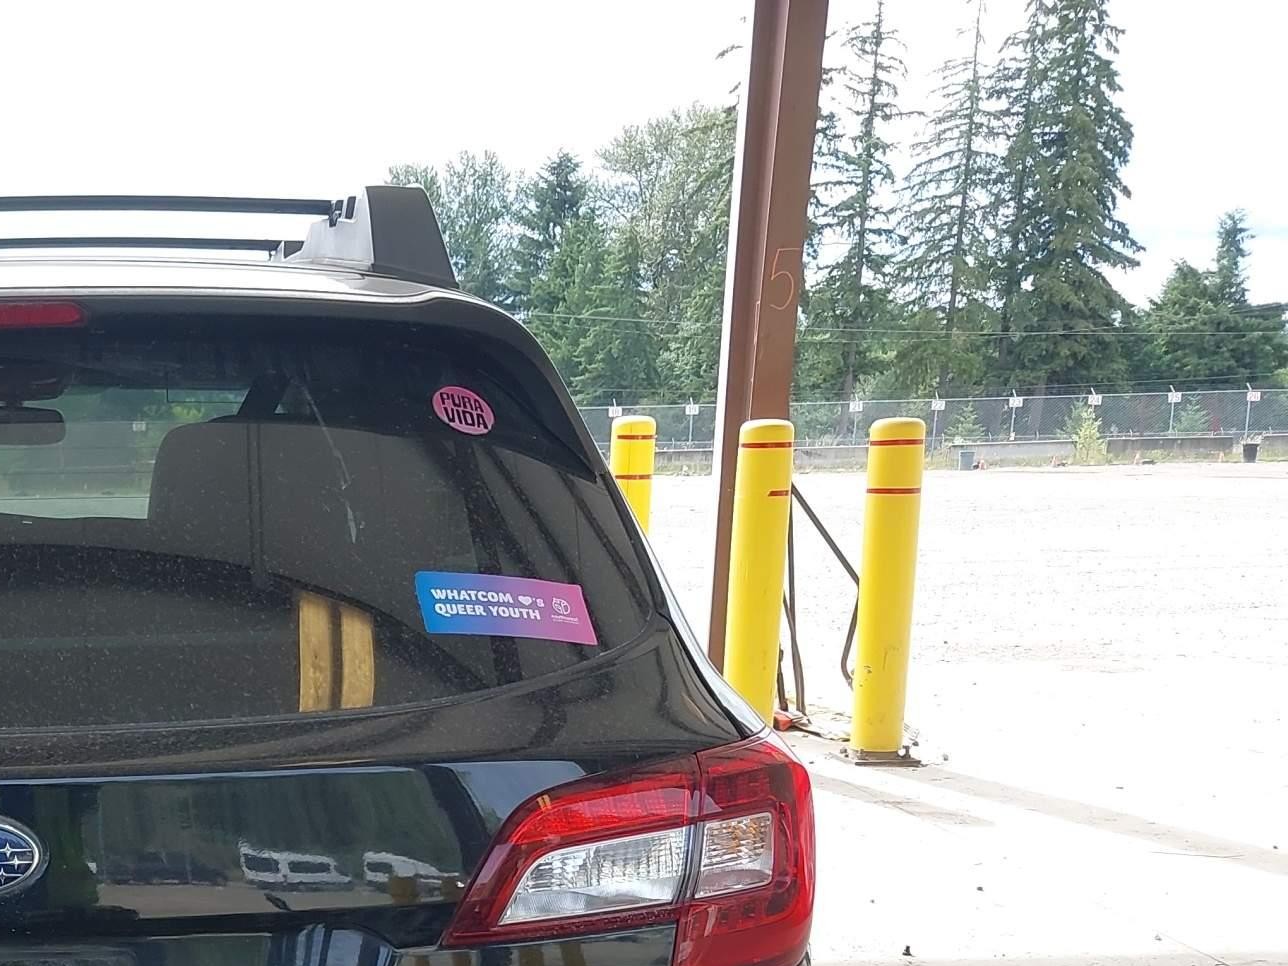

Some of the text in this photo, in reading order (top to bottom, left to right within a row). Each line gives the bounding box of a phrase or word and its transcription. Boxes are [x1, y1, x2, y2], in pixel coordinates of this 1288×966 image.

[769, 247, 802, 310] 5
[439, 391, 484, 413] PURA
[442, 406, 489, 430] VIDA
[430, 588, 514, 604] WHATCOM
[434, 602, 487, 617] QUEER
[488, 605, 542, 621] YOUTH
